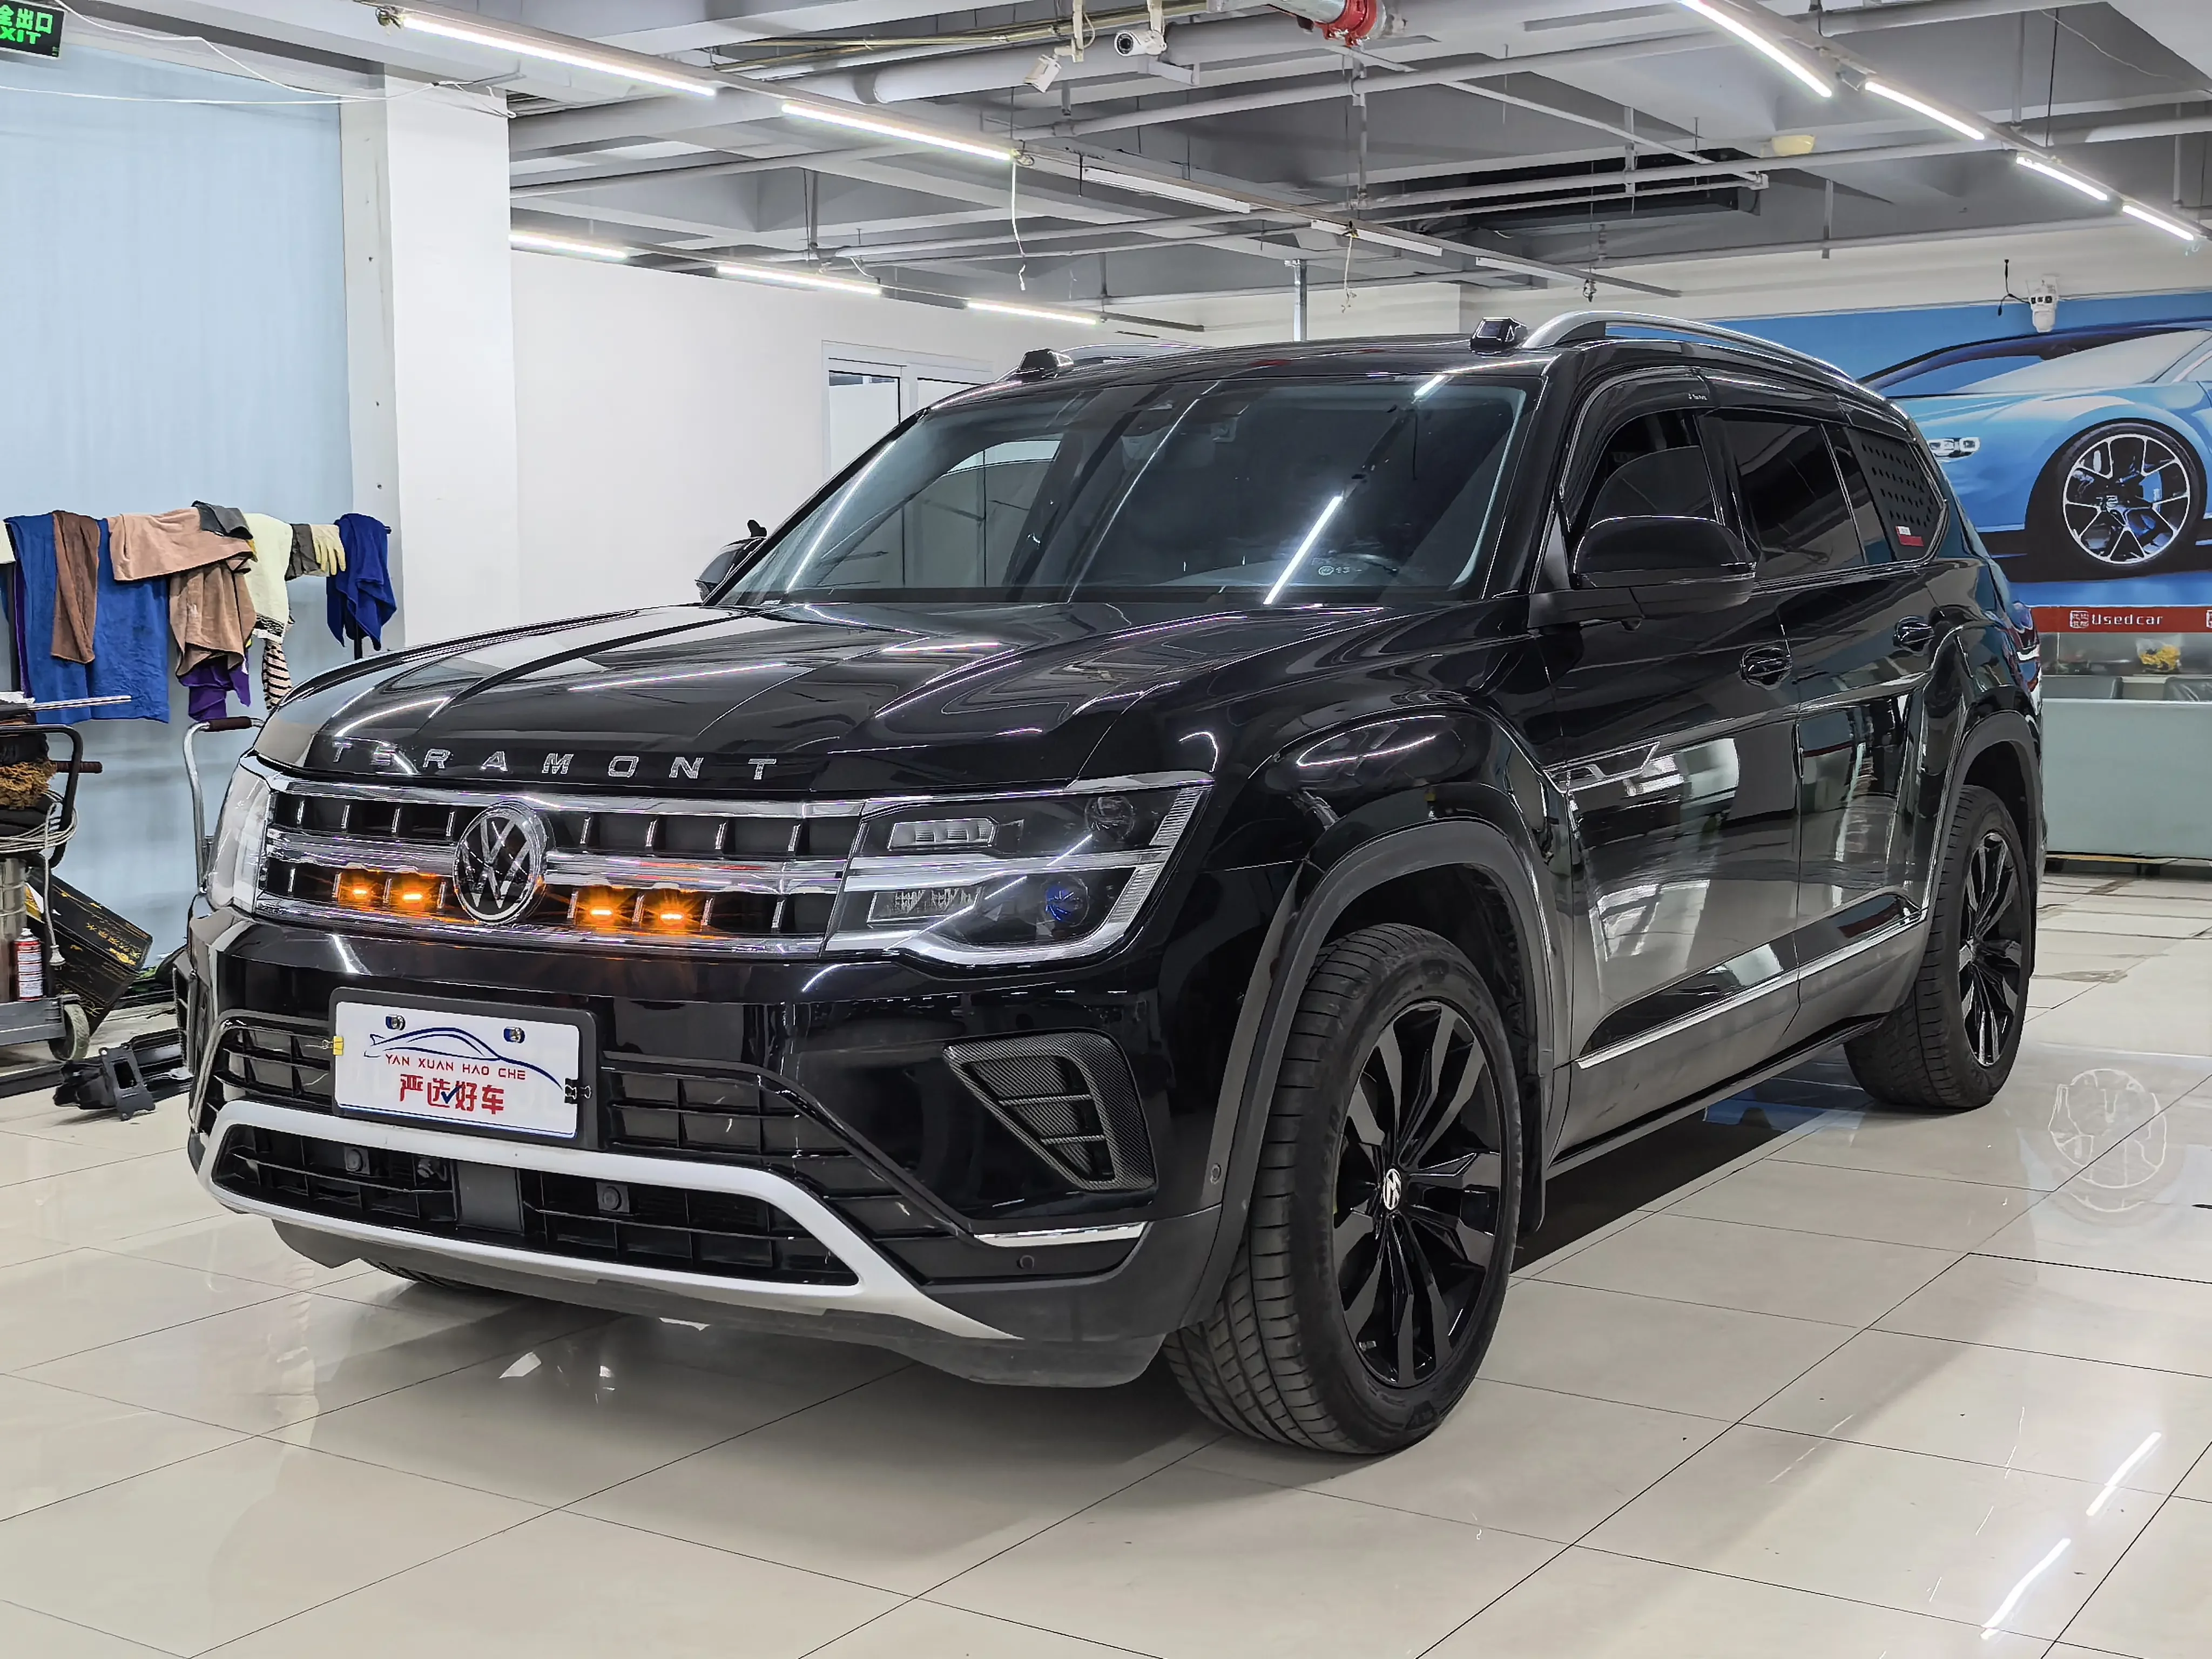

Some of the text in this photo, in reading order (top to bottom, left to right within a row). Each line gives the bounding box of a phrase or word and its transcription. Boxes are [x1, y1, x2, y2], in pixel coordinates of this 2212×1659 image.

[0, 4, 53, 33] 全出口
[332, 740, 777, 780] TERAMONT
[386, 1054, 526, 1080] YAN XUAN HAO CHE
[400, 1073, 504, 1115] 严选好车
